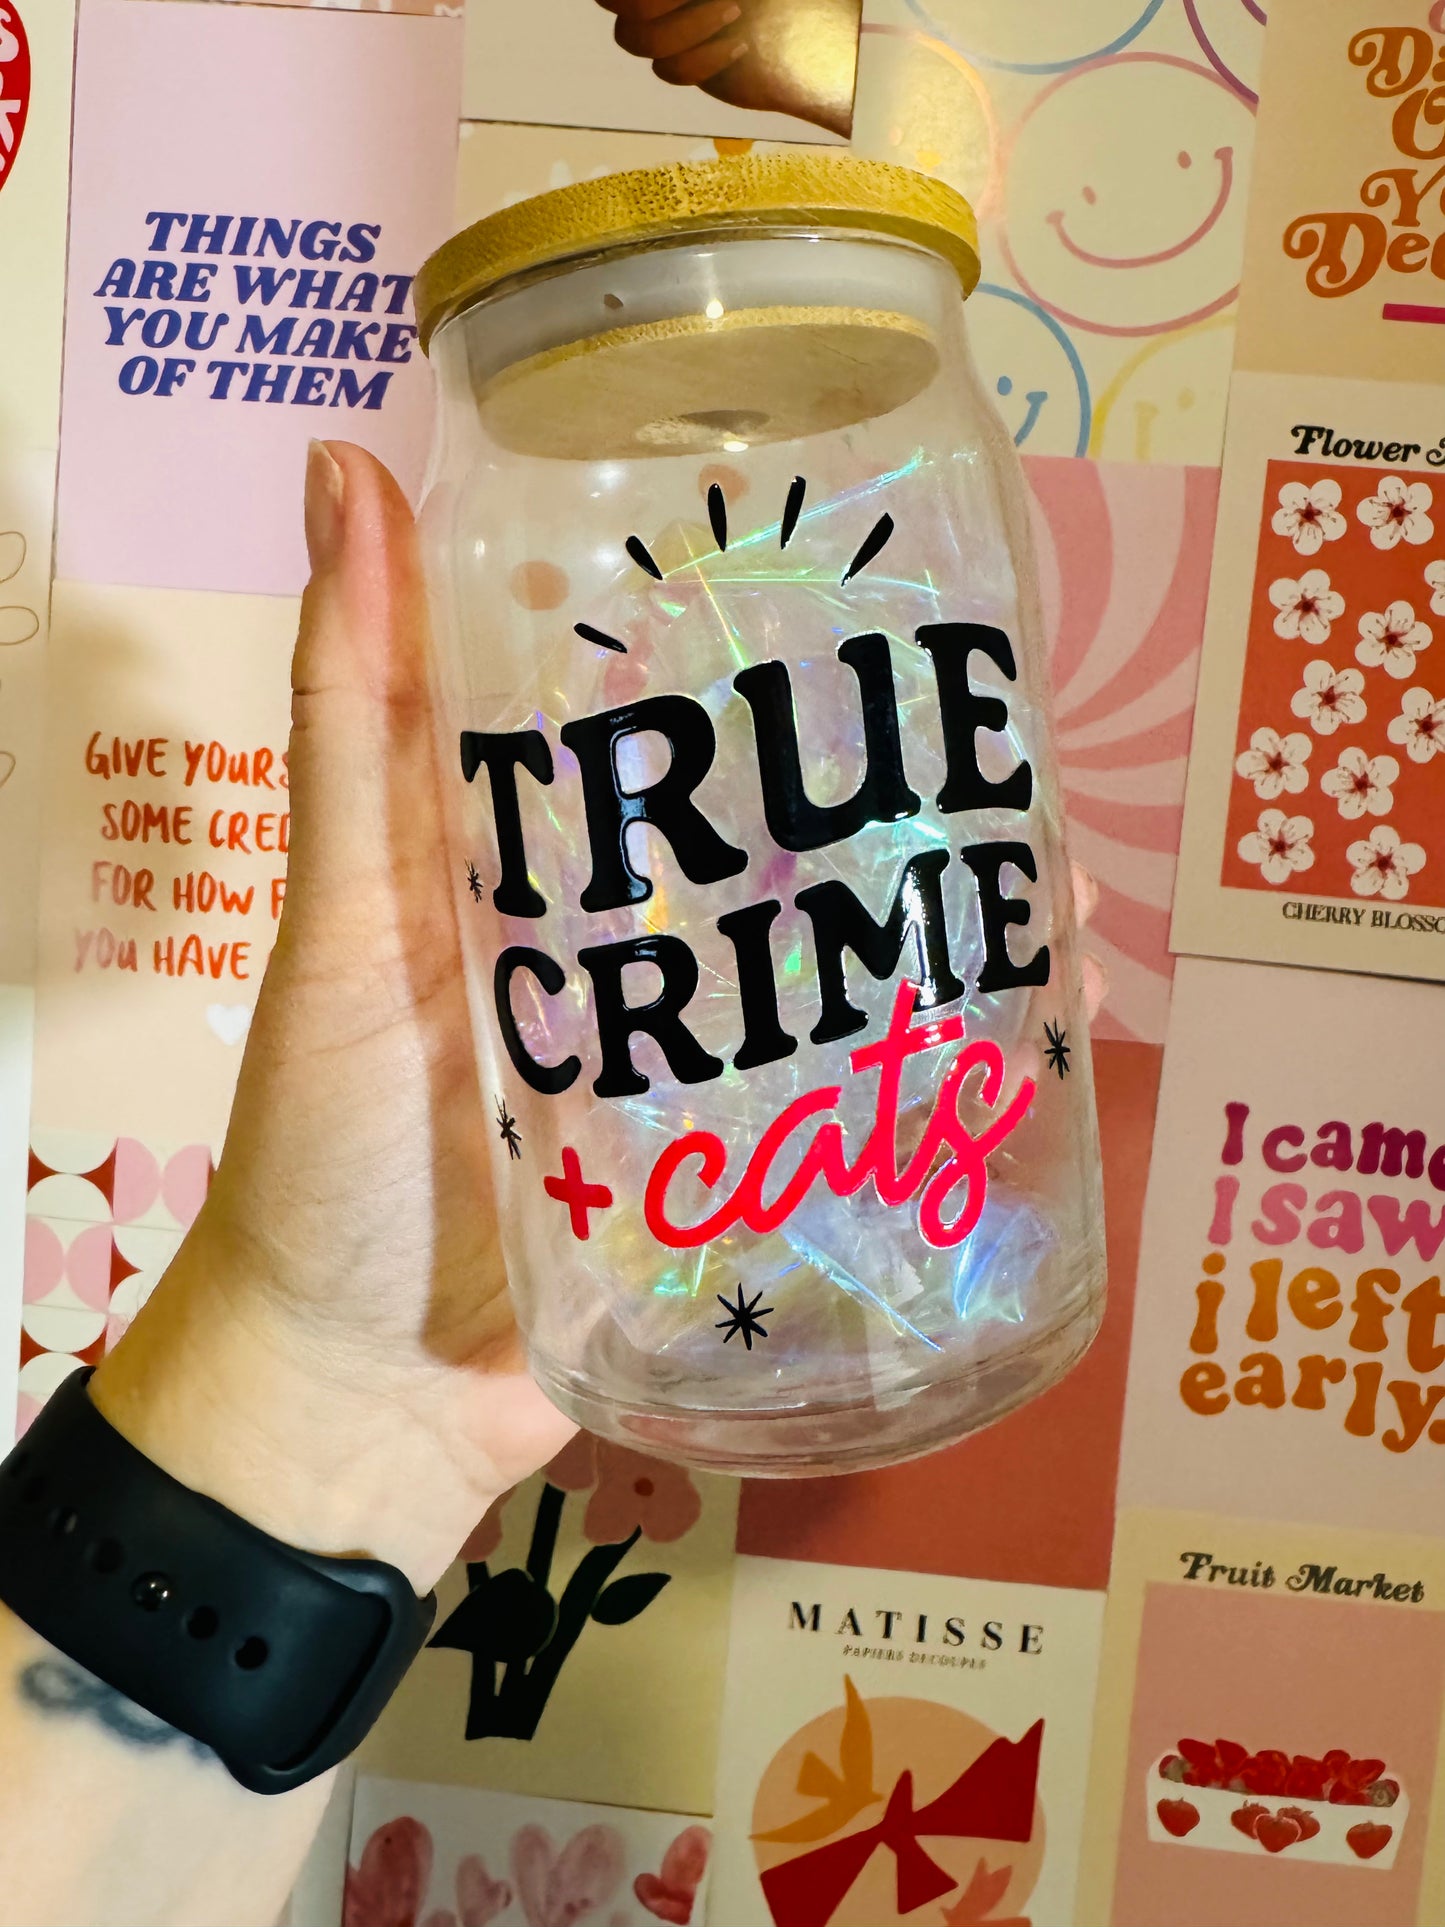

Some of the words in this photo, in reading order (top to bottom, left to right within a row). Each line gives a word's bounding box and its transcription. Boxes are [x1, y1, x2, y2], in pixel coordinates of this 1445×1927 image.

[145, 211, 381, 264] THINGS
[93, 258, 218, 303] ARE
[233, 265, 415, 314] WHAT
[103, 306, 229, 351] YOU
[235, 314, 418, 364] MAKE
[118, 356, 196, 397] OF
[206, 361, 394, 410] THEM
[1291, 424, 1421, 462] Flower
[85, 731, 169, 781] GIVE
[460, 622, 1033, 918] TRUE
[100, 799, 192, 845] SOME
[91, 861, 157, 911] FOR
[173, 871, 255, 915] HOW
[1282, 901, 1366, 927] CHERRY
[73, 927, 138, 974] YOU
[153, 933, 252, 980] HAVE
[494, 841, 1050, 1098] CRIME
[645, 978, 1037, 1249] cats
[1221, 1101, 1250, 1165] I
[1208, 1174, 1240, 1246] I
[1251, 1182, 1445, 1262] saw
[1189, 1251, 1225, 1355] i
[1246, 1257, 1445, 1373] left
[1180, 1551, 1276, 1588] Fruit
[1285, 1563, 1425, 1603] Market
[788, 1601, 1045, 1655] MATISSE
